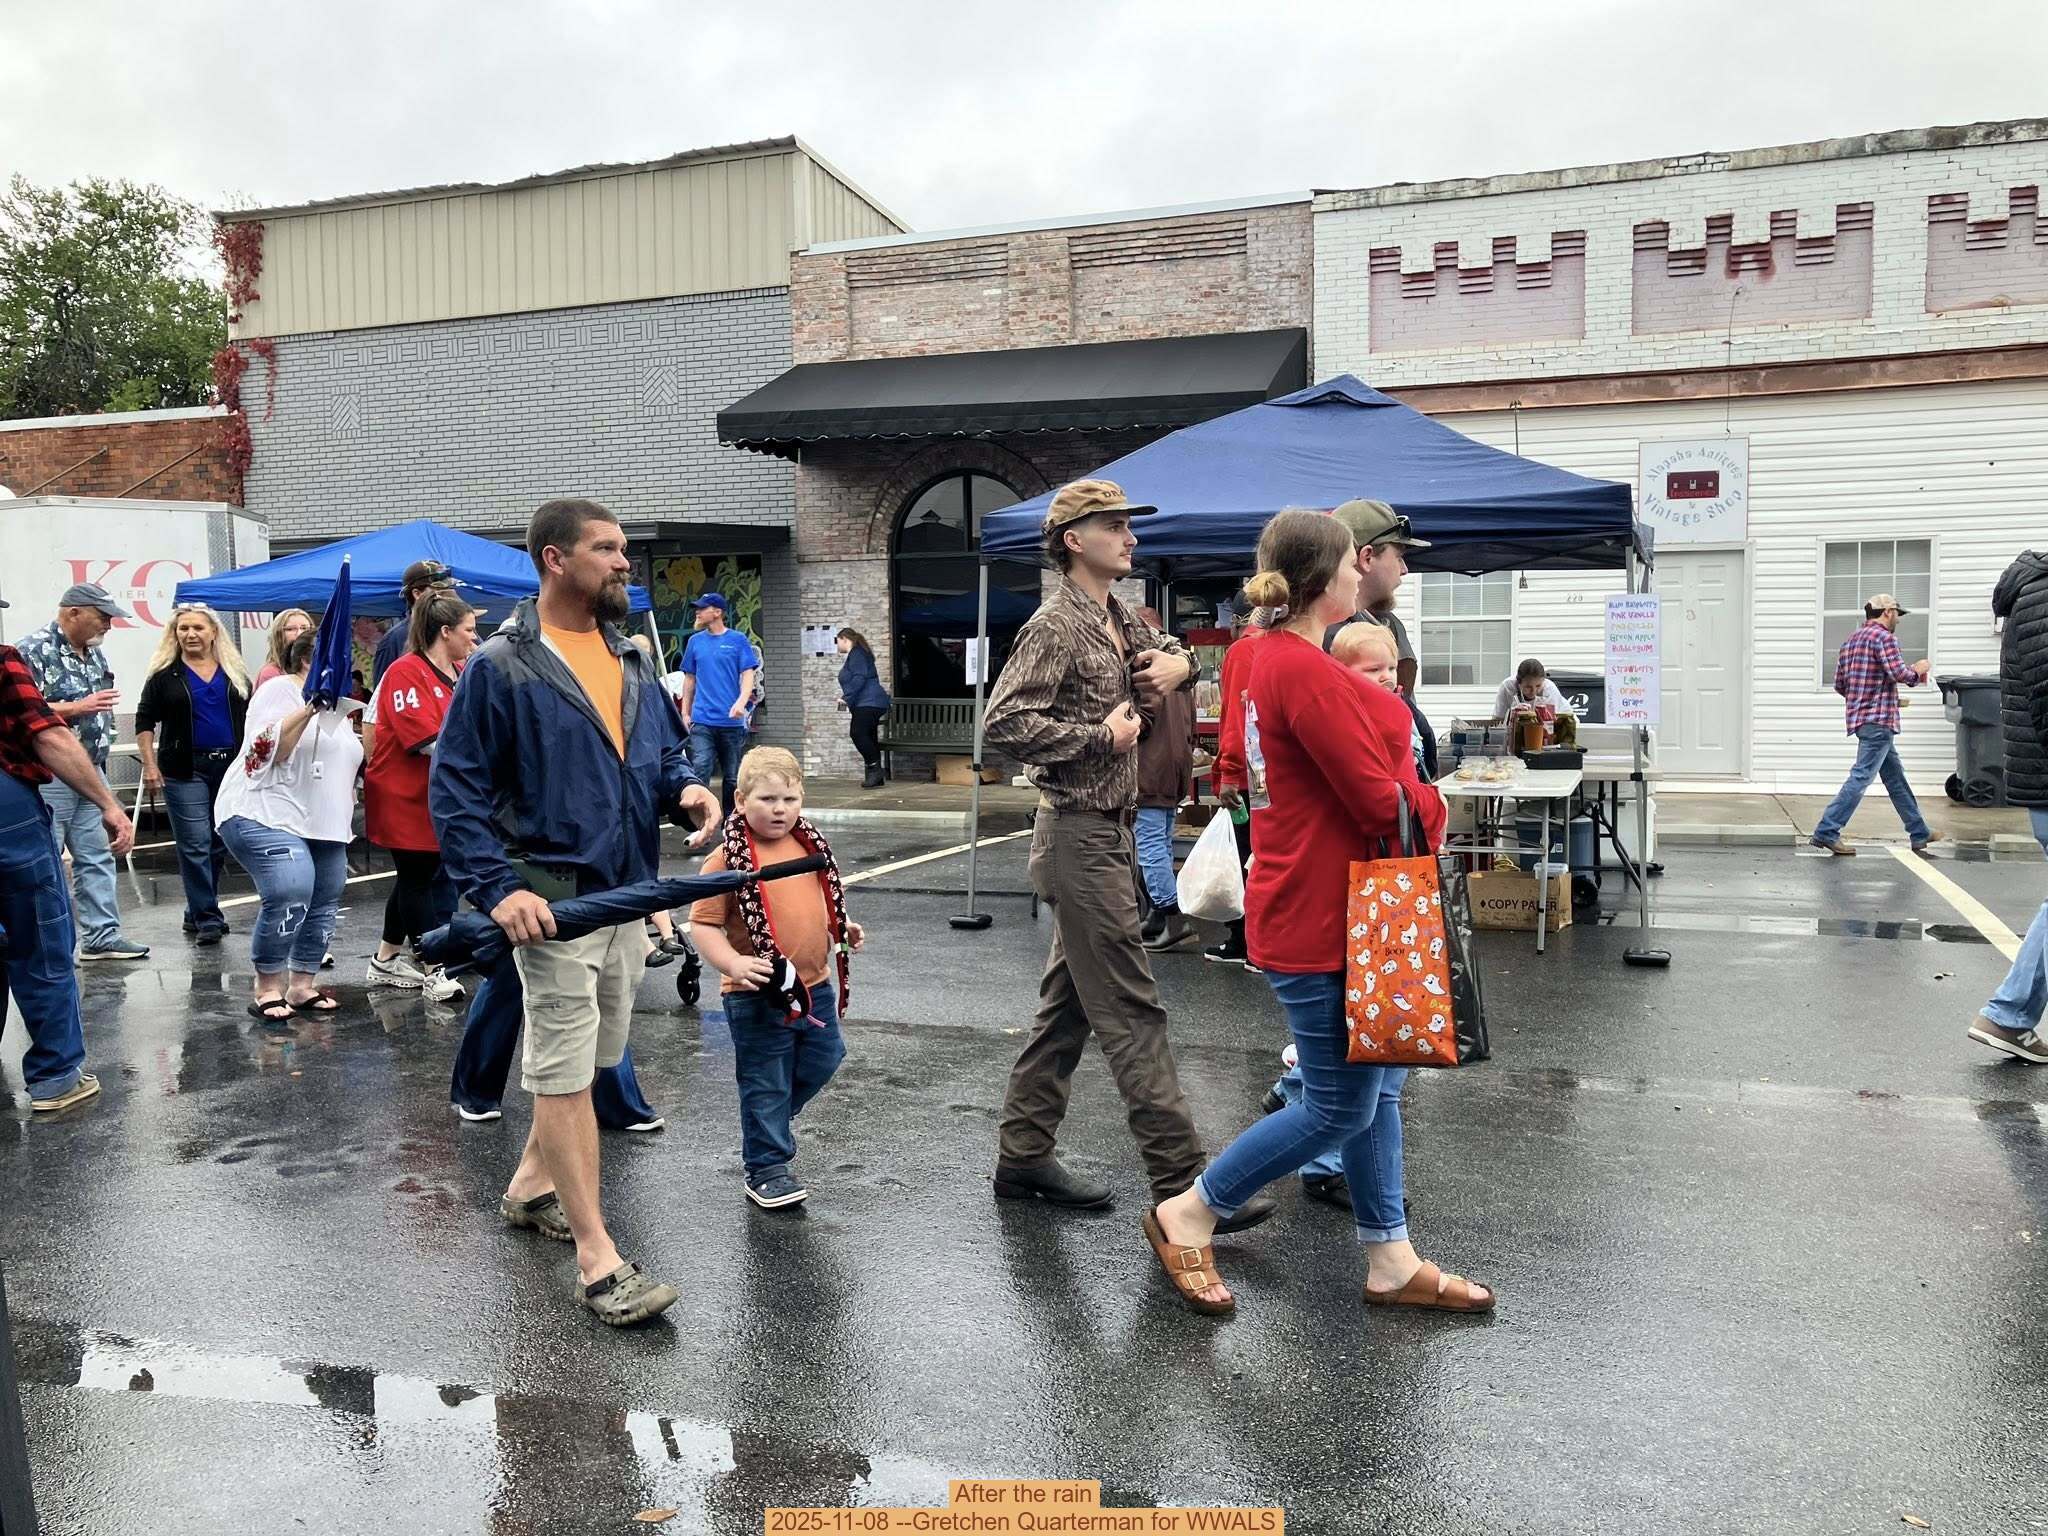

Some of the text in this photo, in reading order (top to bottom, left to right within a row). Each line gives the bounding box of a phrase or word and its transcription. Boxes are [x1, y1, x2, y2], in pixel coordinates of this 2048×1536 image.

[1644, 489, 1742, 527] Vintage Shop
[393, 686, 420, 713] 84
[1487, 899, 1558, 911] COPY PAER
